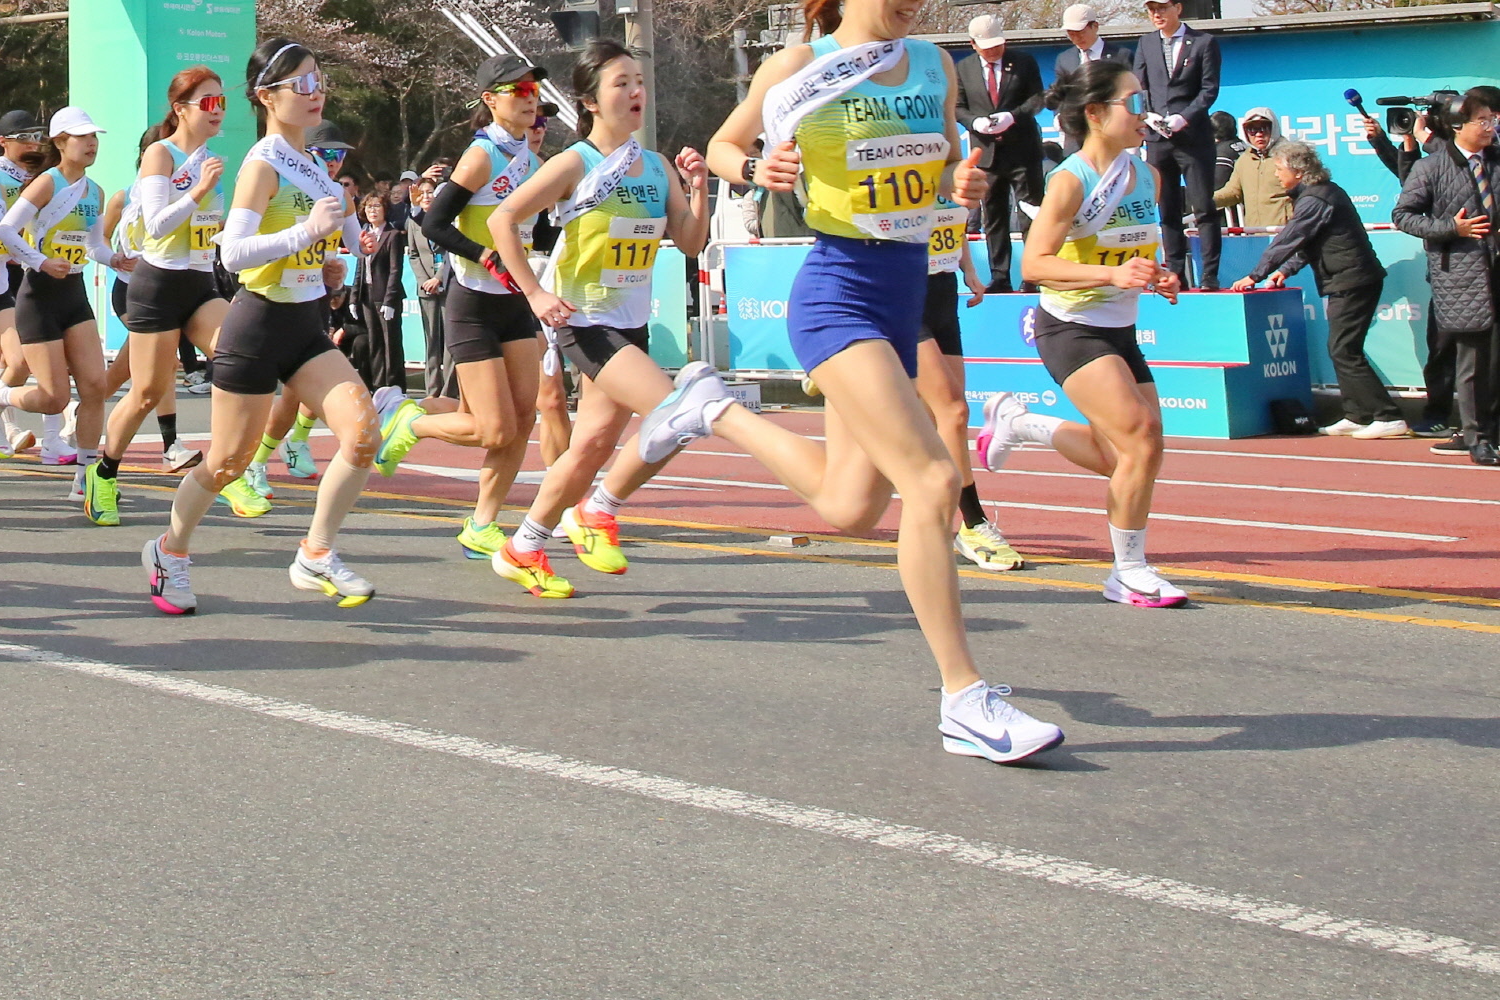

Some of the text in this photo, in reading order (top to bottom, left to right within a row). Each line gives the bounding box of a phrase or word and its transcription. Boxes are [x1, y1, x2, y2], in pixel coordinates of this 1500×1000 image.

[840, 96, 893, 124] TEAM
[1280, 112, 1381, 156] 라톤
[857, 142, 945, 162] TEAM CROWN
[615, 184, 661, 205] 런앤런
[858, 169, 937, 209] 110-1
[1350, 194, 1379, 203] AMPYO
[611, 241, 653, 267] 111
[624, 274, 648, 283] KOLON
[1263, 360, 1297, 378] KOLON
[964, 390, 998, 400] 한육상연
[1011, 391, 1040, 404] KBS
[1158, 396, 1207, 410] KOLON
